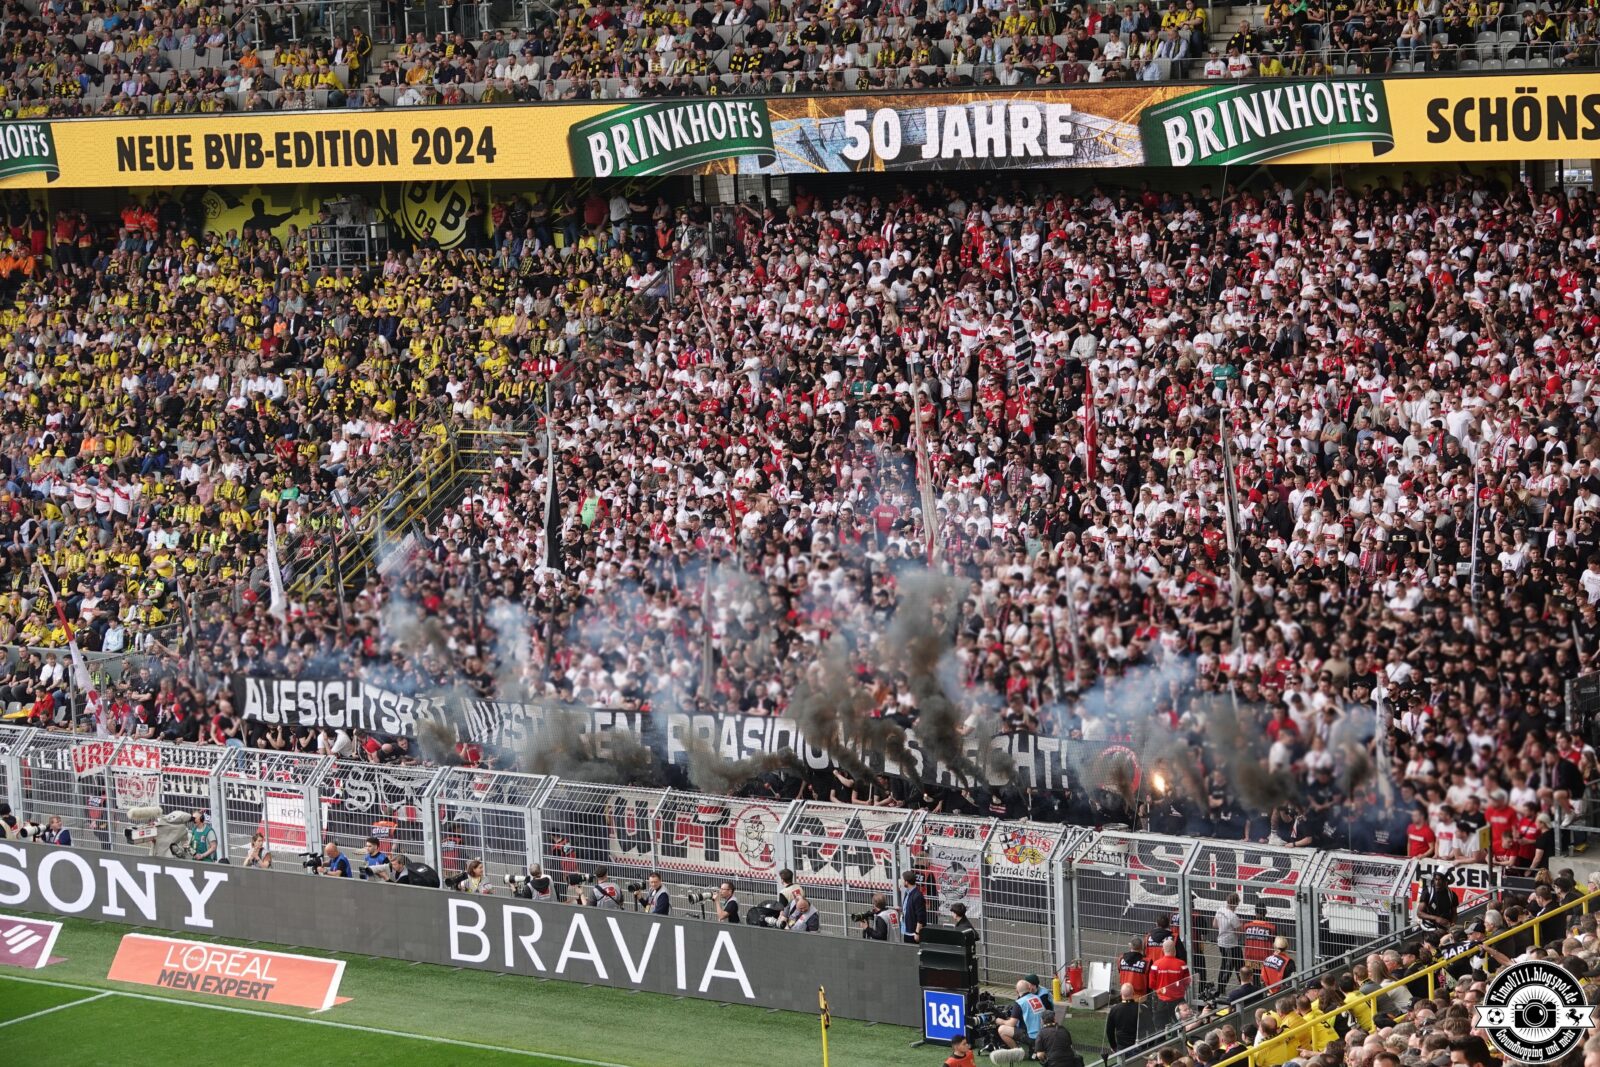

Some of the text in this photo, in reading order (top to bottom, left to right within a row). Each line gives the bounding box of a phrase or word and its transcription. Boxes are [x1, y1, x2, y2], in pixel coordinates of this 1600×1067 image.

[116, 125, 497, 172] NEUE BVB-EDITION 2024
[842, 103, 1074, 161] 50 JAHRE
[73, 742, 161, 773] URBACH
[0, 842, 228, 929] SONY
[164, 945, 278, 982] L'ORÉAL
[447, 898, 756, 999] BRAVIA
[157, 969, 274, 1001] MEN EXPERT
[928, 1001, 961, 1029] 1&1
